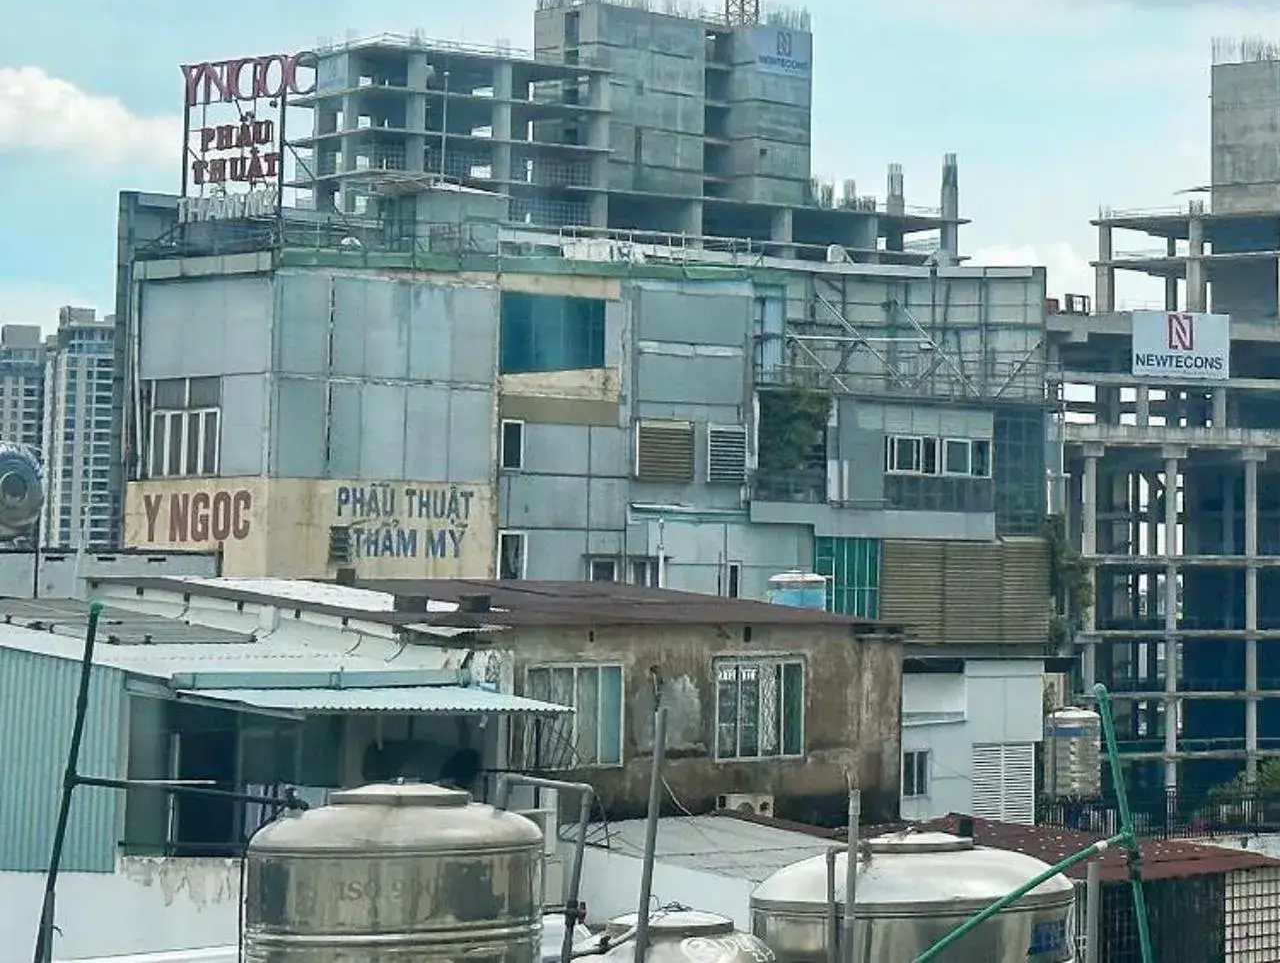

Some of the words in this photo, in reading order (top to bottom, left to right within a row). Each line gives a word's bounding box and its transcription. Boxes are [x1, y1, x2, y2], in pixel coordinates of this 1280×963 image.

[1135, 352, 1223, 370] NEWTECONS
[143, 493, 163, 542] Y
[405, 483, 475, 524] THUẬT
[425, 522, 469, 558] MỸ
